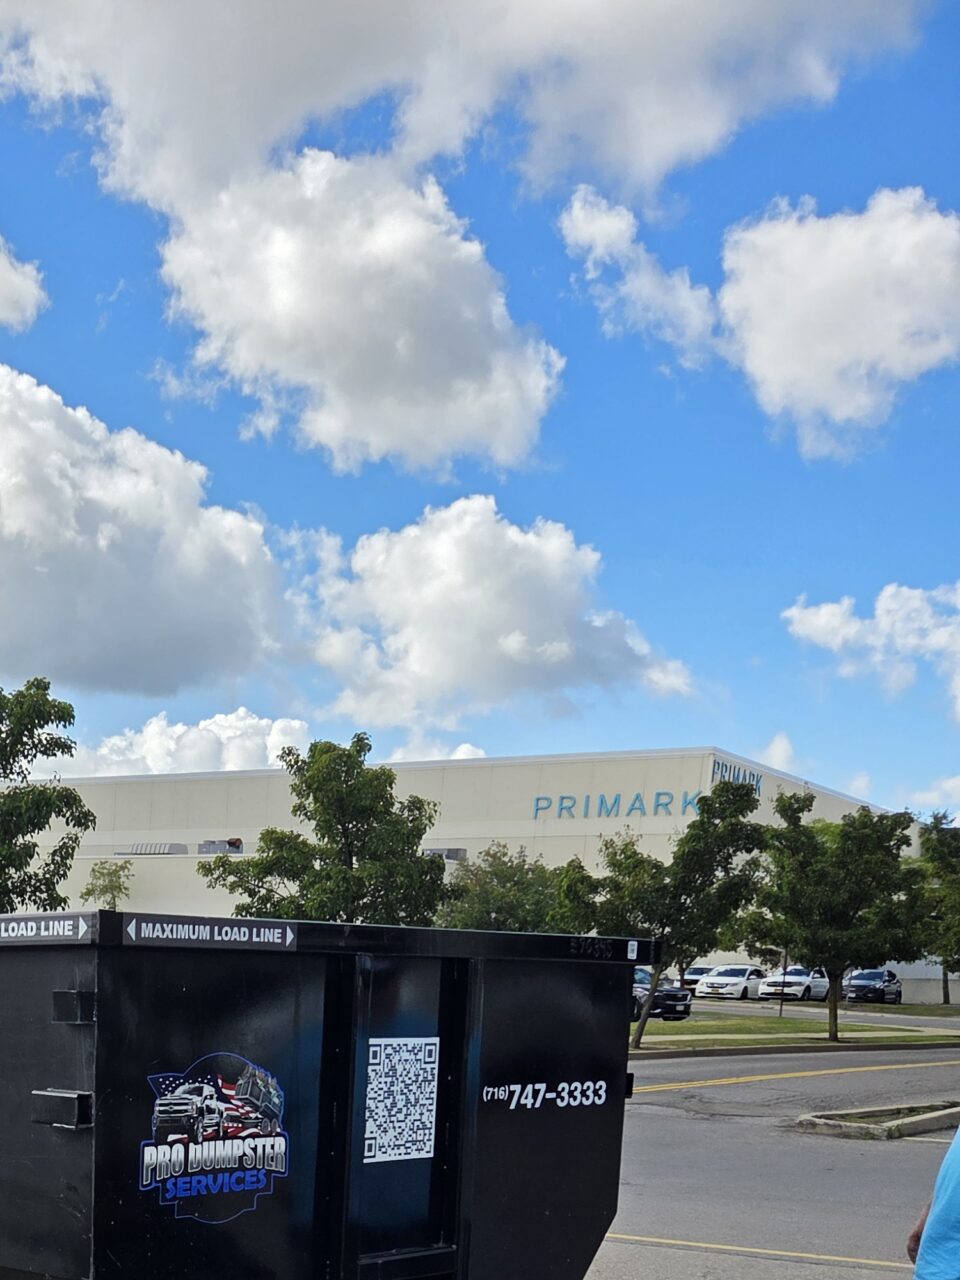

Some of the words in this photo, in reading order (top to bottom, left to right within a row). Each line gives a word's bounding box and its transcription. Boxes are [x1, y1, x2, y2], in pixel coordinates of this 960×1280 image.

[533, 789, 703, 820] PRIMARK
[0, 921, 37, 938] LOAD
[41, 920, 74, 937] LINE
[141, 922, 210, 941] MAXIMUM
[214, 925, 249, 942] LOAD
[252, 927, 282, 943] LINE
[143, 1143, 185, 1185] PRO
[188, 1136, 286, 1172] DUMPSTER
[165, 1168, 267, 1199] SERVICES
